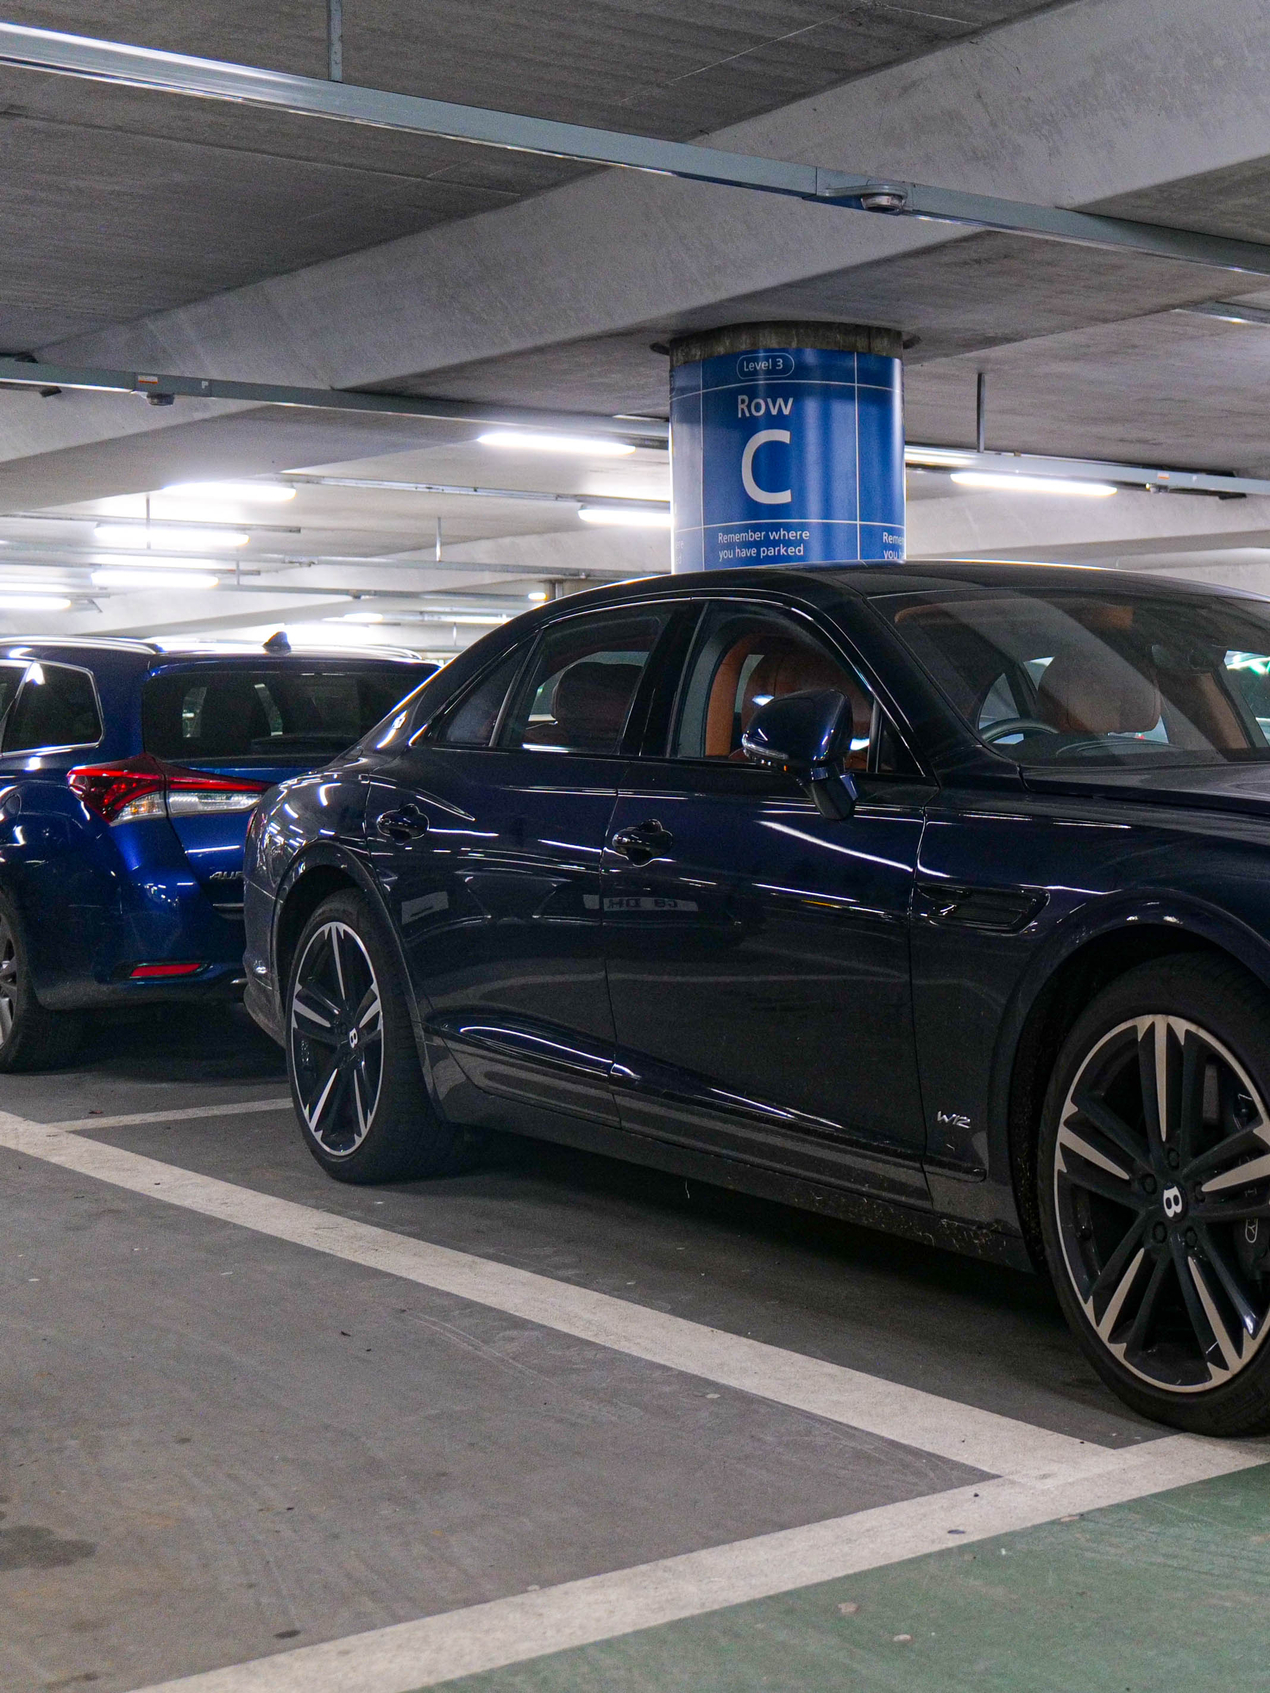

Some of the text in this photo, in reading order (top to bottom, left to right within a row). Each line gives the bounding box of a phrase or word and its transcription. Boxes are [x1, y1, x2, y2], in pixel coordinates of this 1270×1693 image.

[743, 358, 784, 371] Level 3
[737, 394, 794, 418] Row
[741, 428, 792, 505] C
[718, 528, 810, 544] Remember where
[718, 543, 804, 562] you have parked
[937, 1110, 971, 1129] W12
